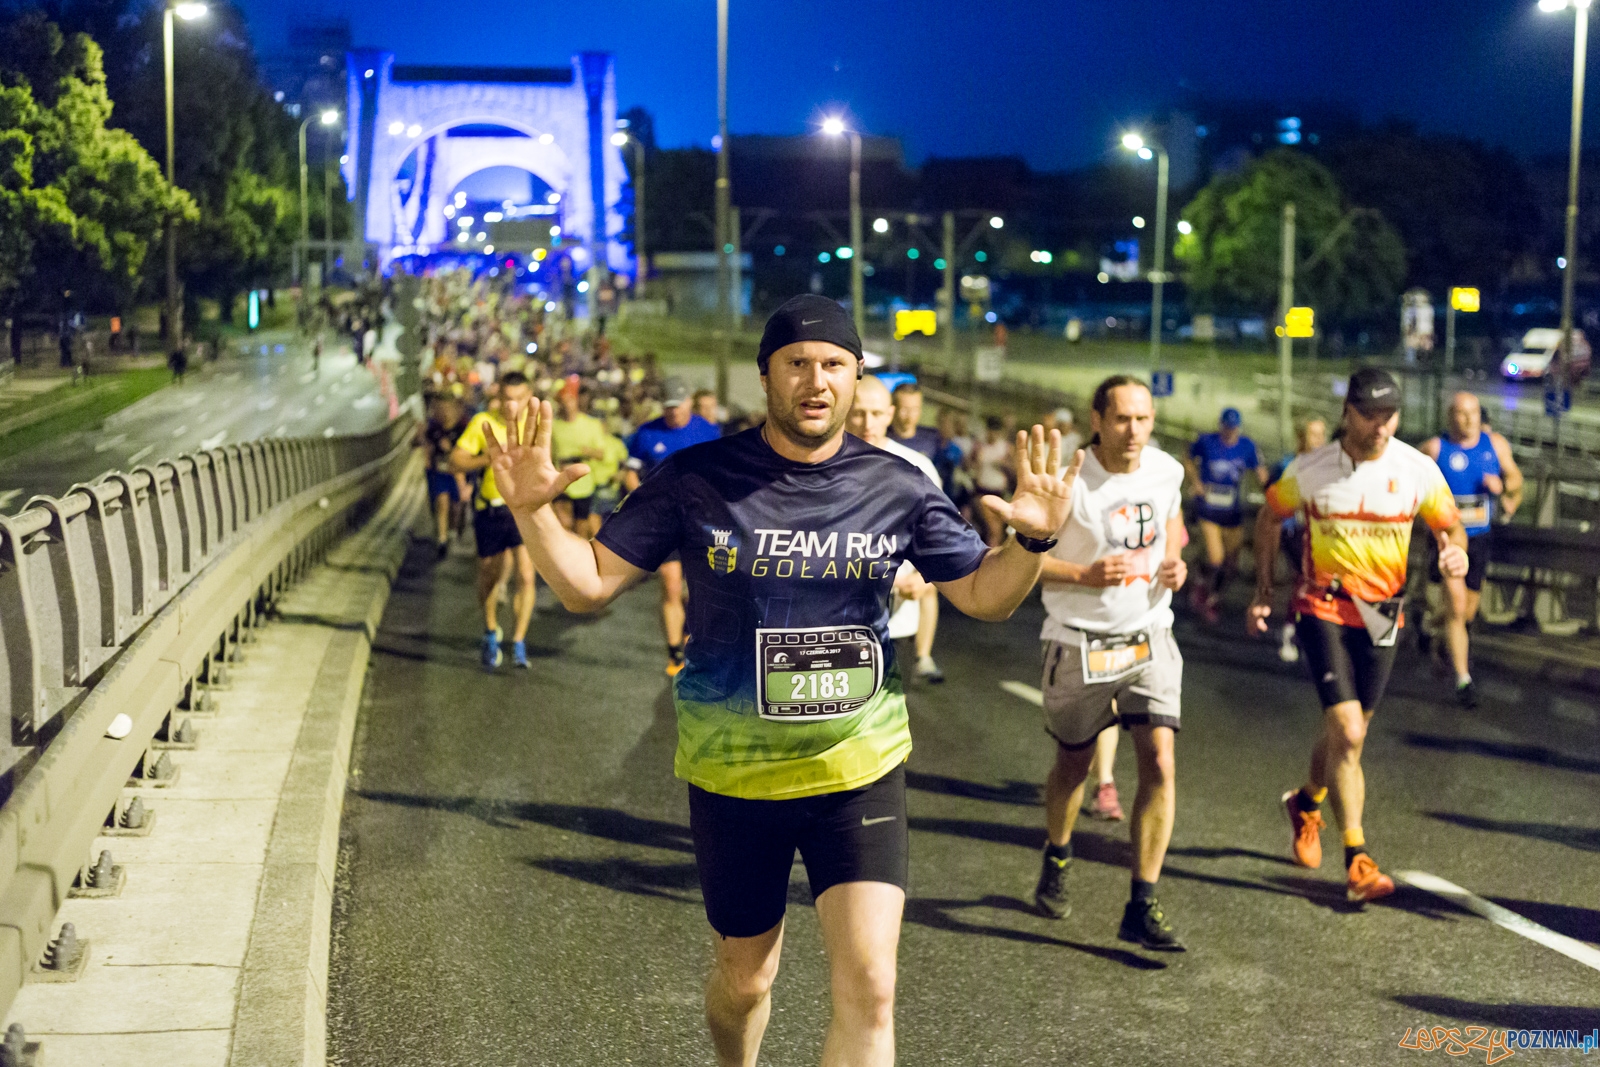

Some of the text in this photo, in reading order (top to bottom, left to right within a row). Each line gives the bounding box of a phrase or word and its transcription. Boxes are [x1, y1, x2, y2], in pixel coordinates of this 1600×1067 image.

[754, 529, 897, 558] TEAM RUN
[791, 672, 849, 699] 2183
